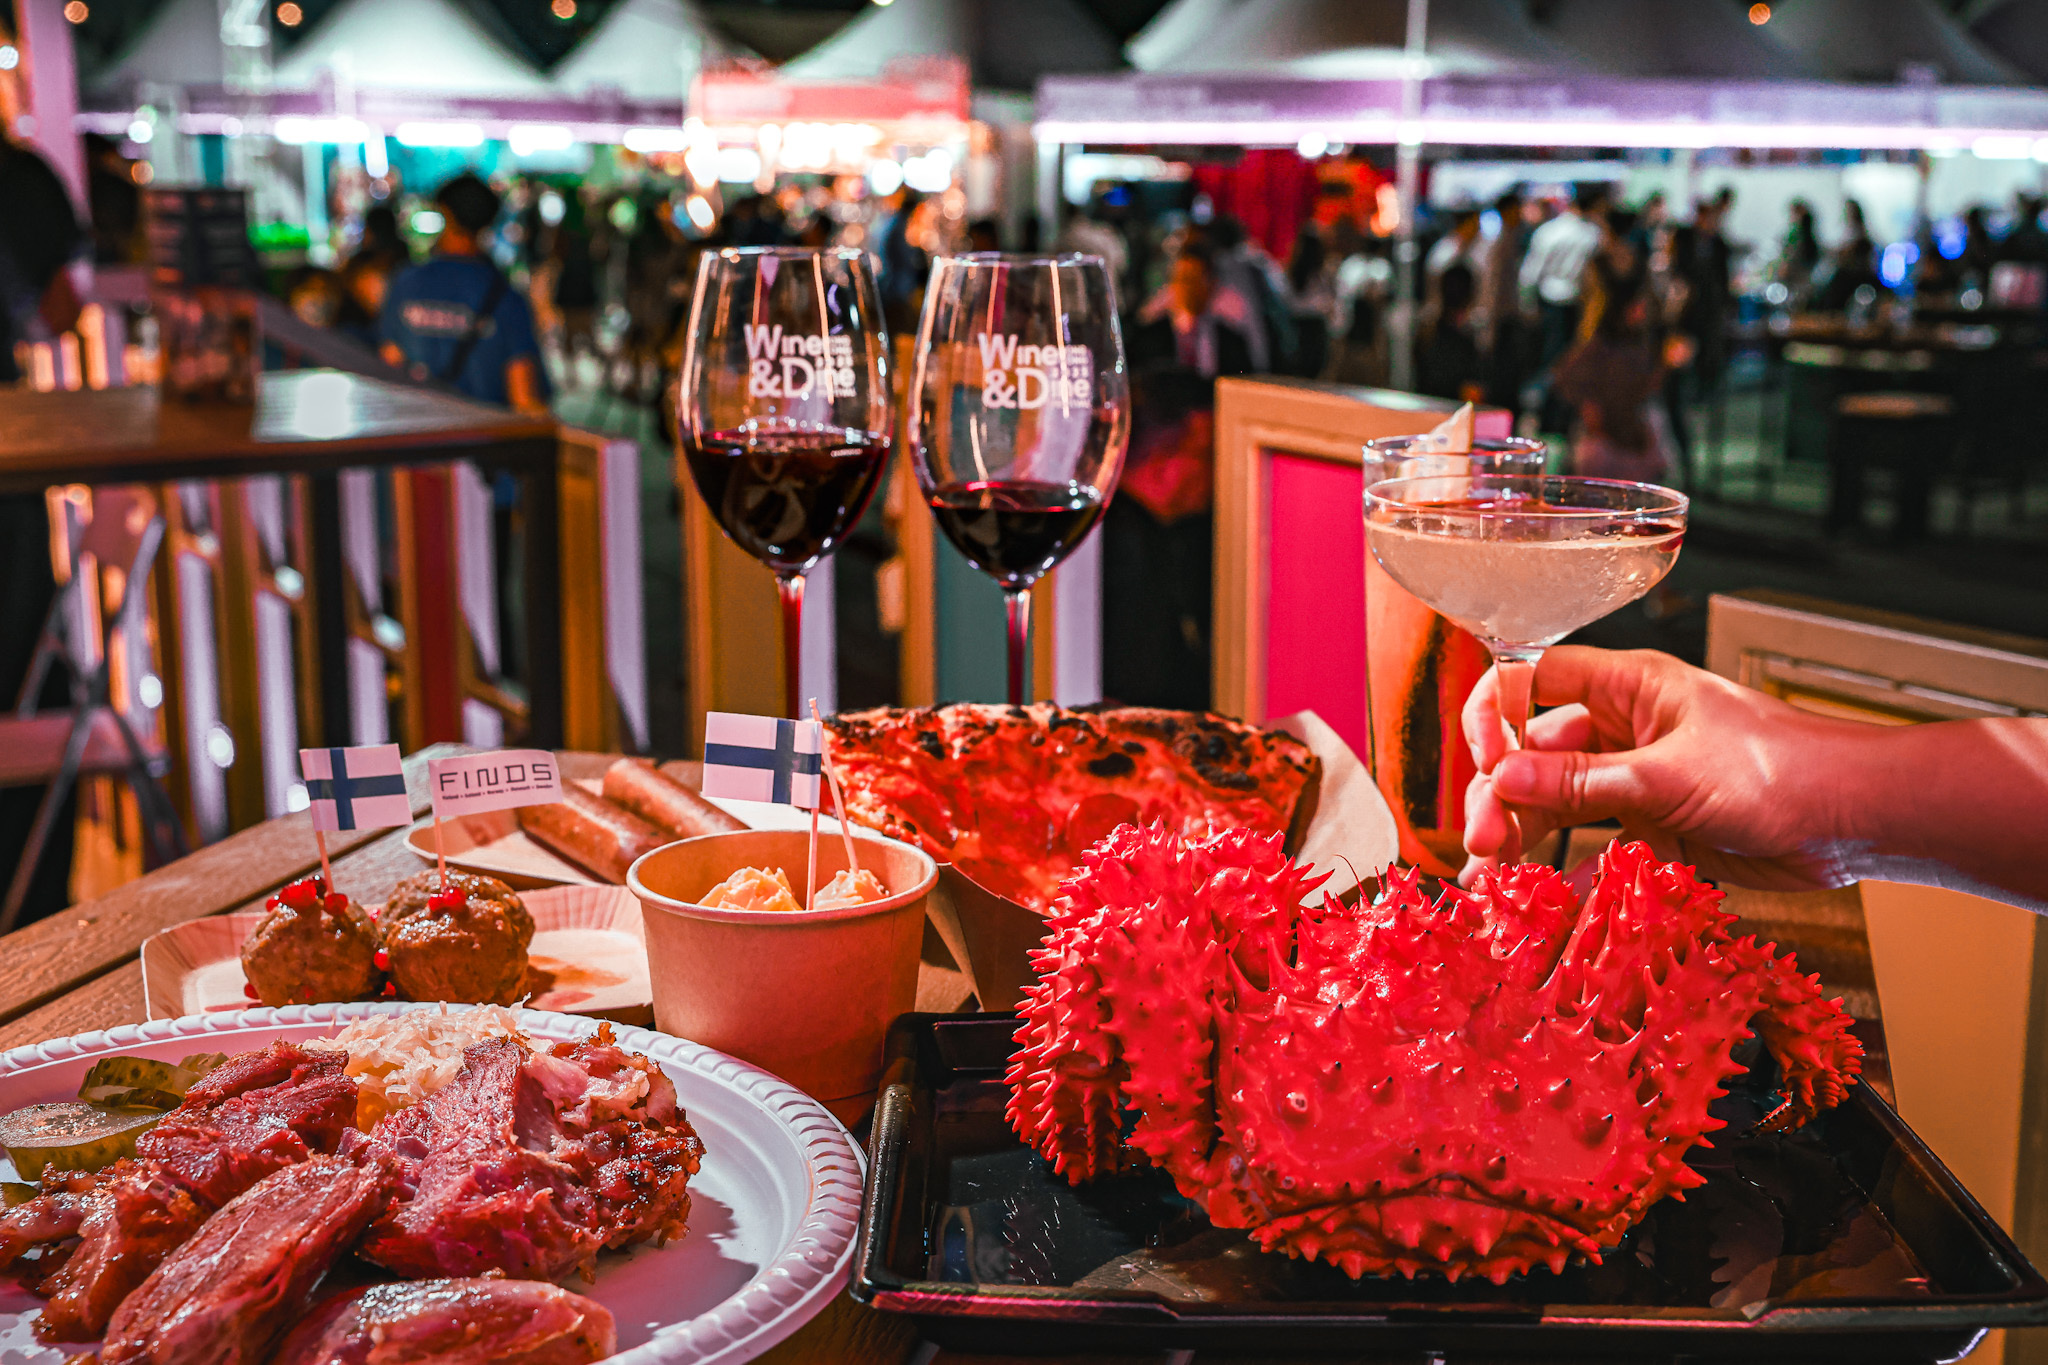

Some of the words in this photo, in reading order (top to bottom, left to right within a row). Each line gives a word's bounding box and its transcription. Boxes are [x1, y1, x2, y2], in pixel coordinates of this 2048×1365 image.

[743, 324, 823, 361] Wine
[977, 332, 1059, 370] Wine
[439, 763, 552, 792] FINDS
